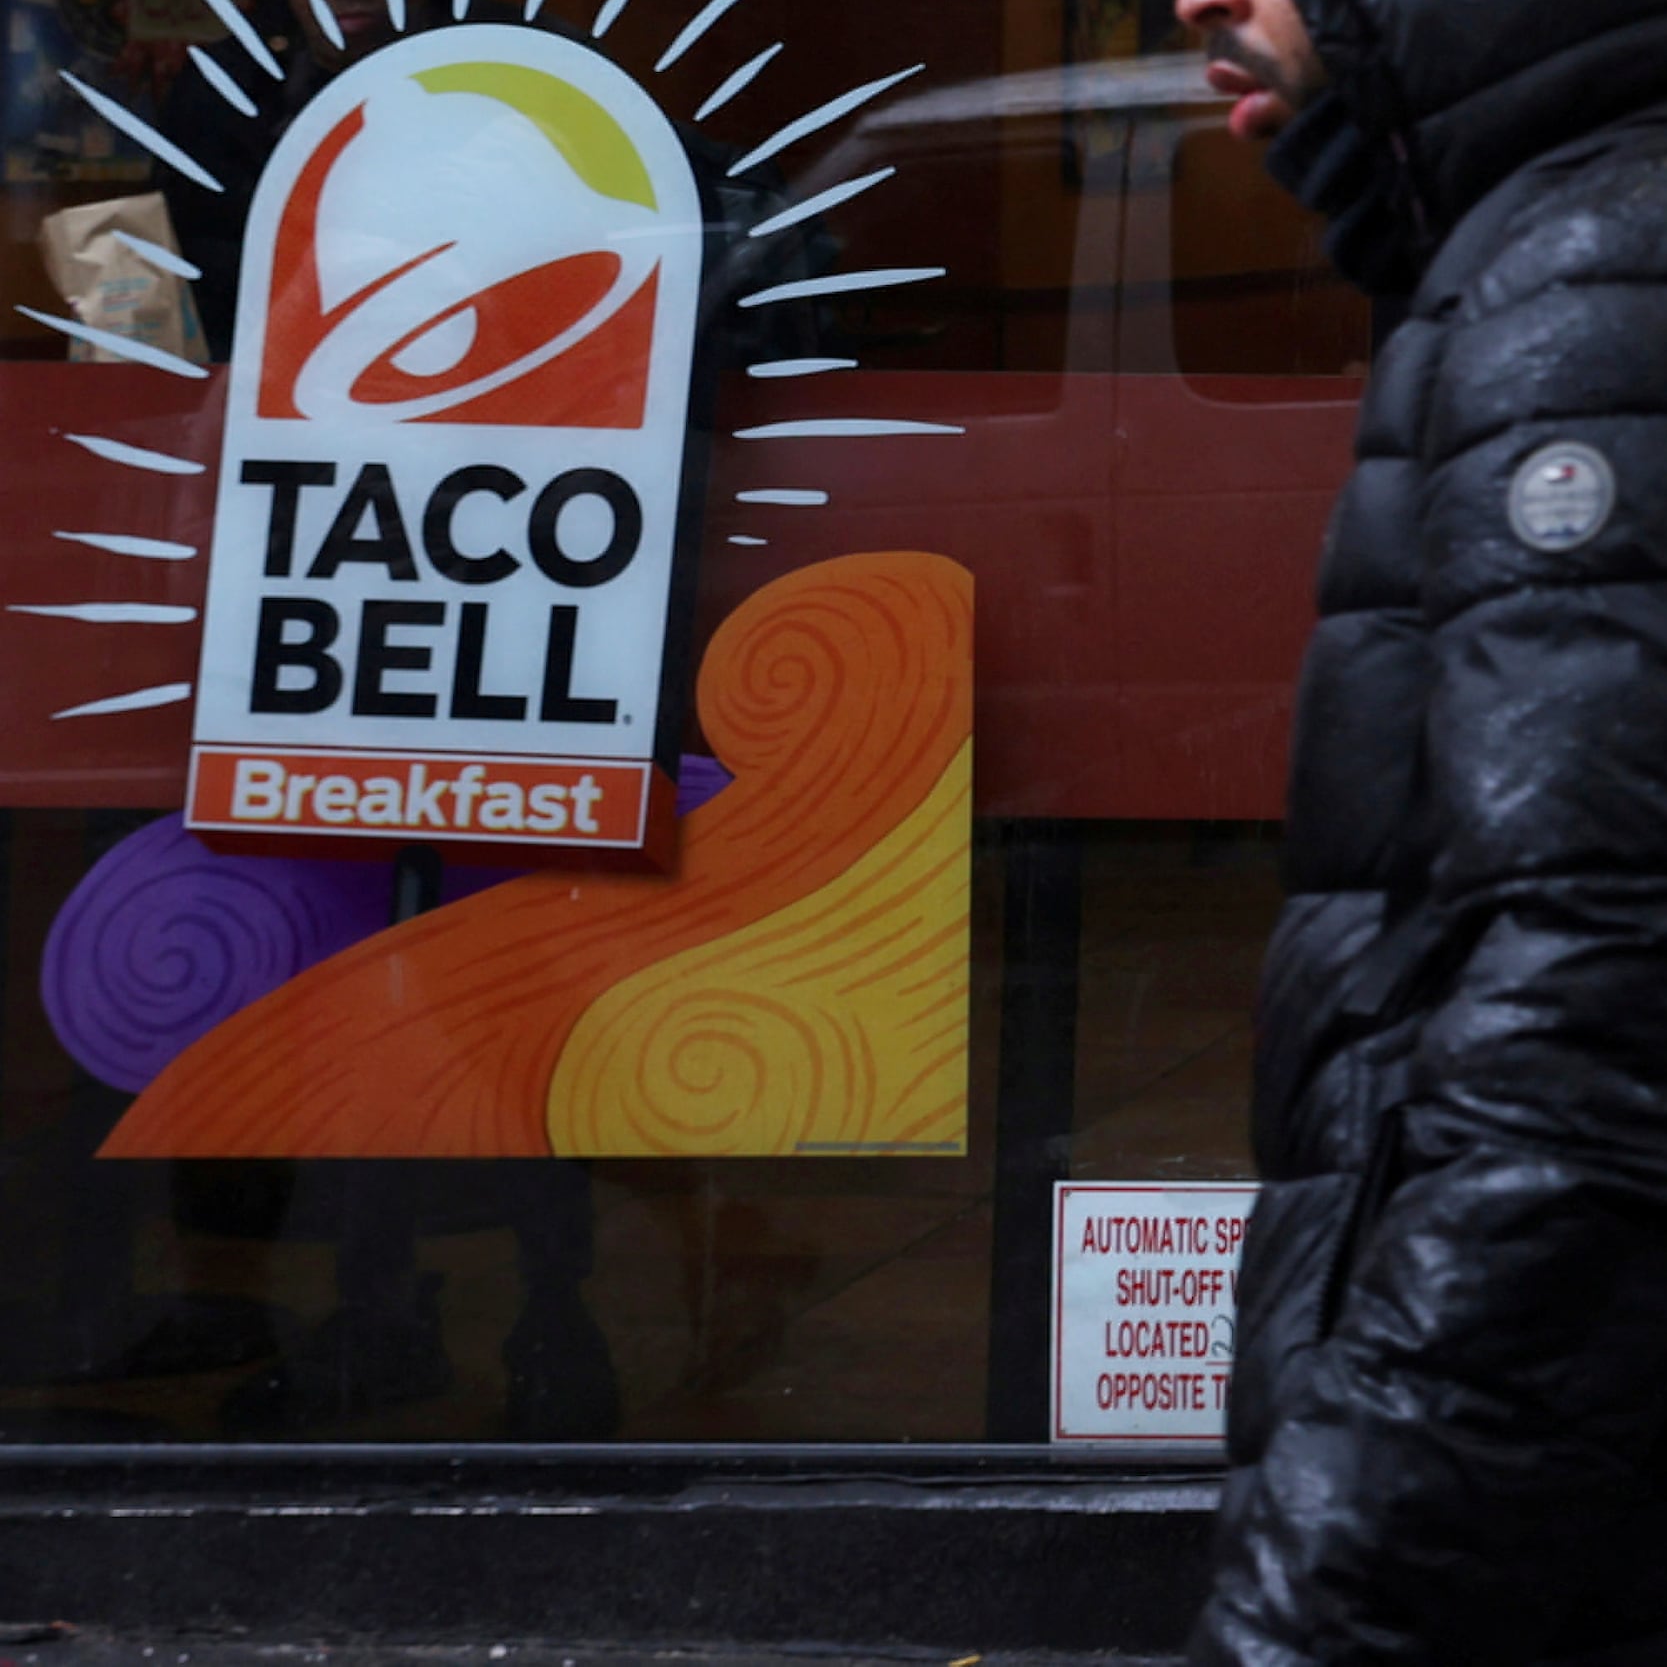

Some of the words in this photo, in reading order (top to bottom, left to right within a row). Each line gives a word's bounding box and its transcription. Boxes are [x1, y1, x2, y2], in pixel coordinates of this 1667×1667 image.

[239, 458, 644, 589] TACO
[248, 595, 619, 725] BELL
[230, 758, 603, 833] Breakfast
[1081, 1216, 1208, 1255] AUTOMATIC
[1115, 1269, 1224, 1306] SHUT-OFF
[1105, 1320, 1211, 1358] LOCATED
[1096, 1373, 1206, 1411] OPPOSITE
[1211, 1373, 1233, 1411] T
